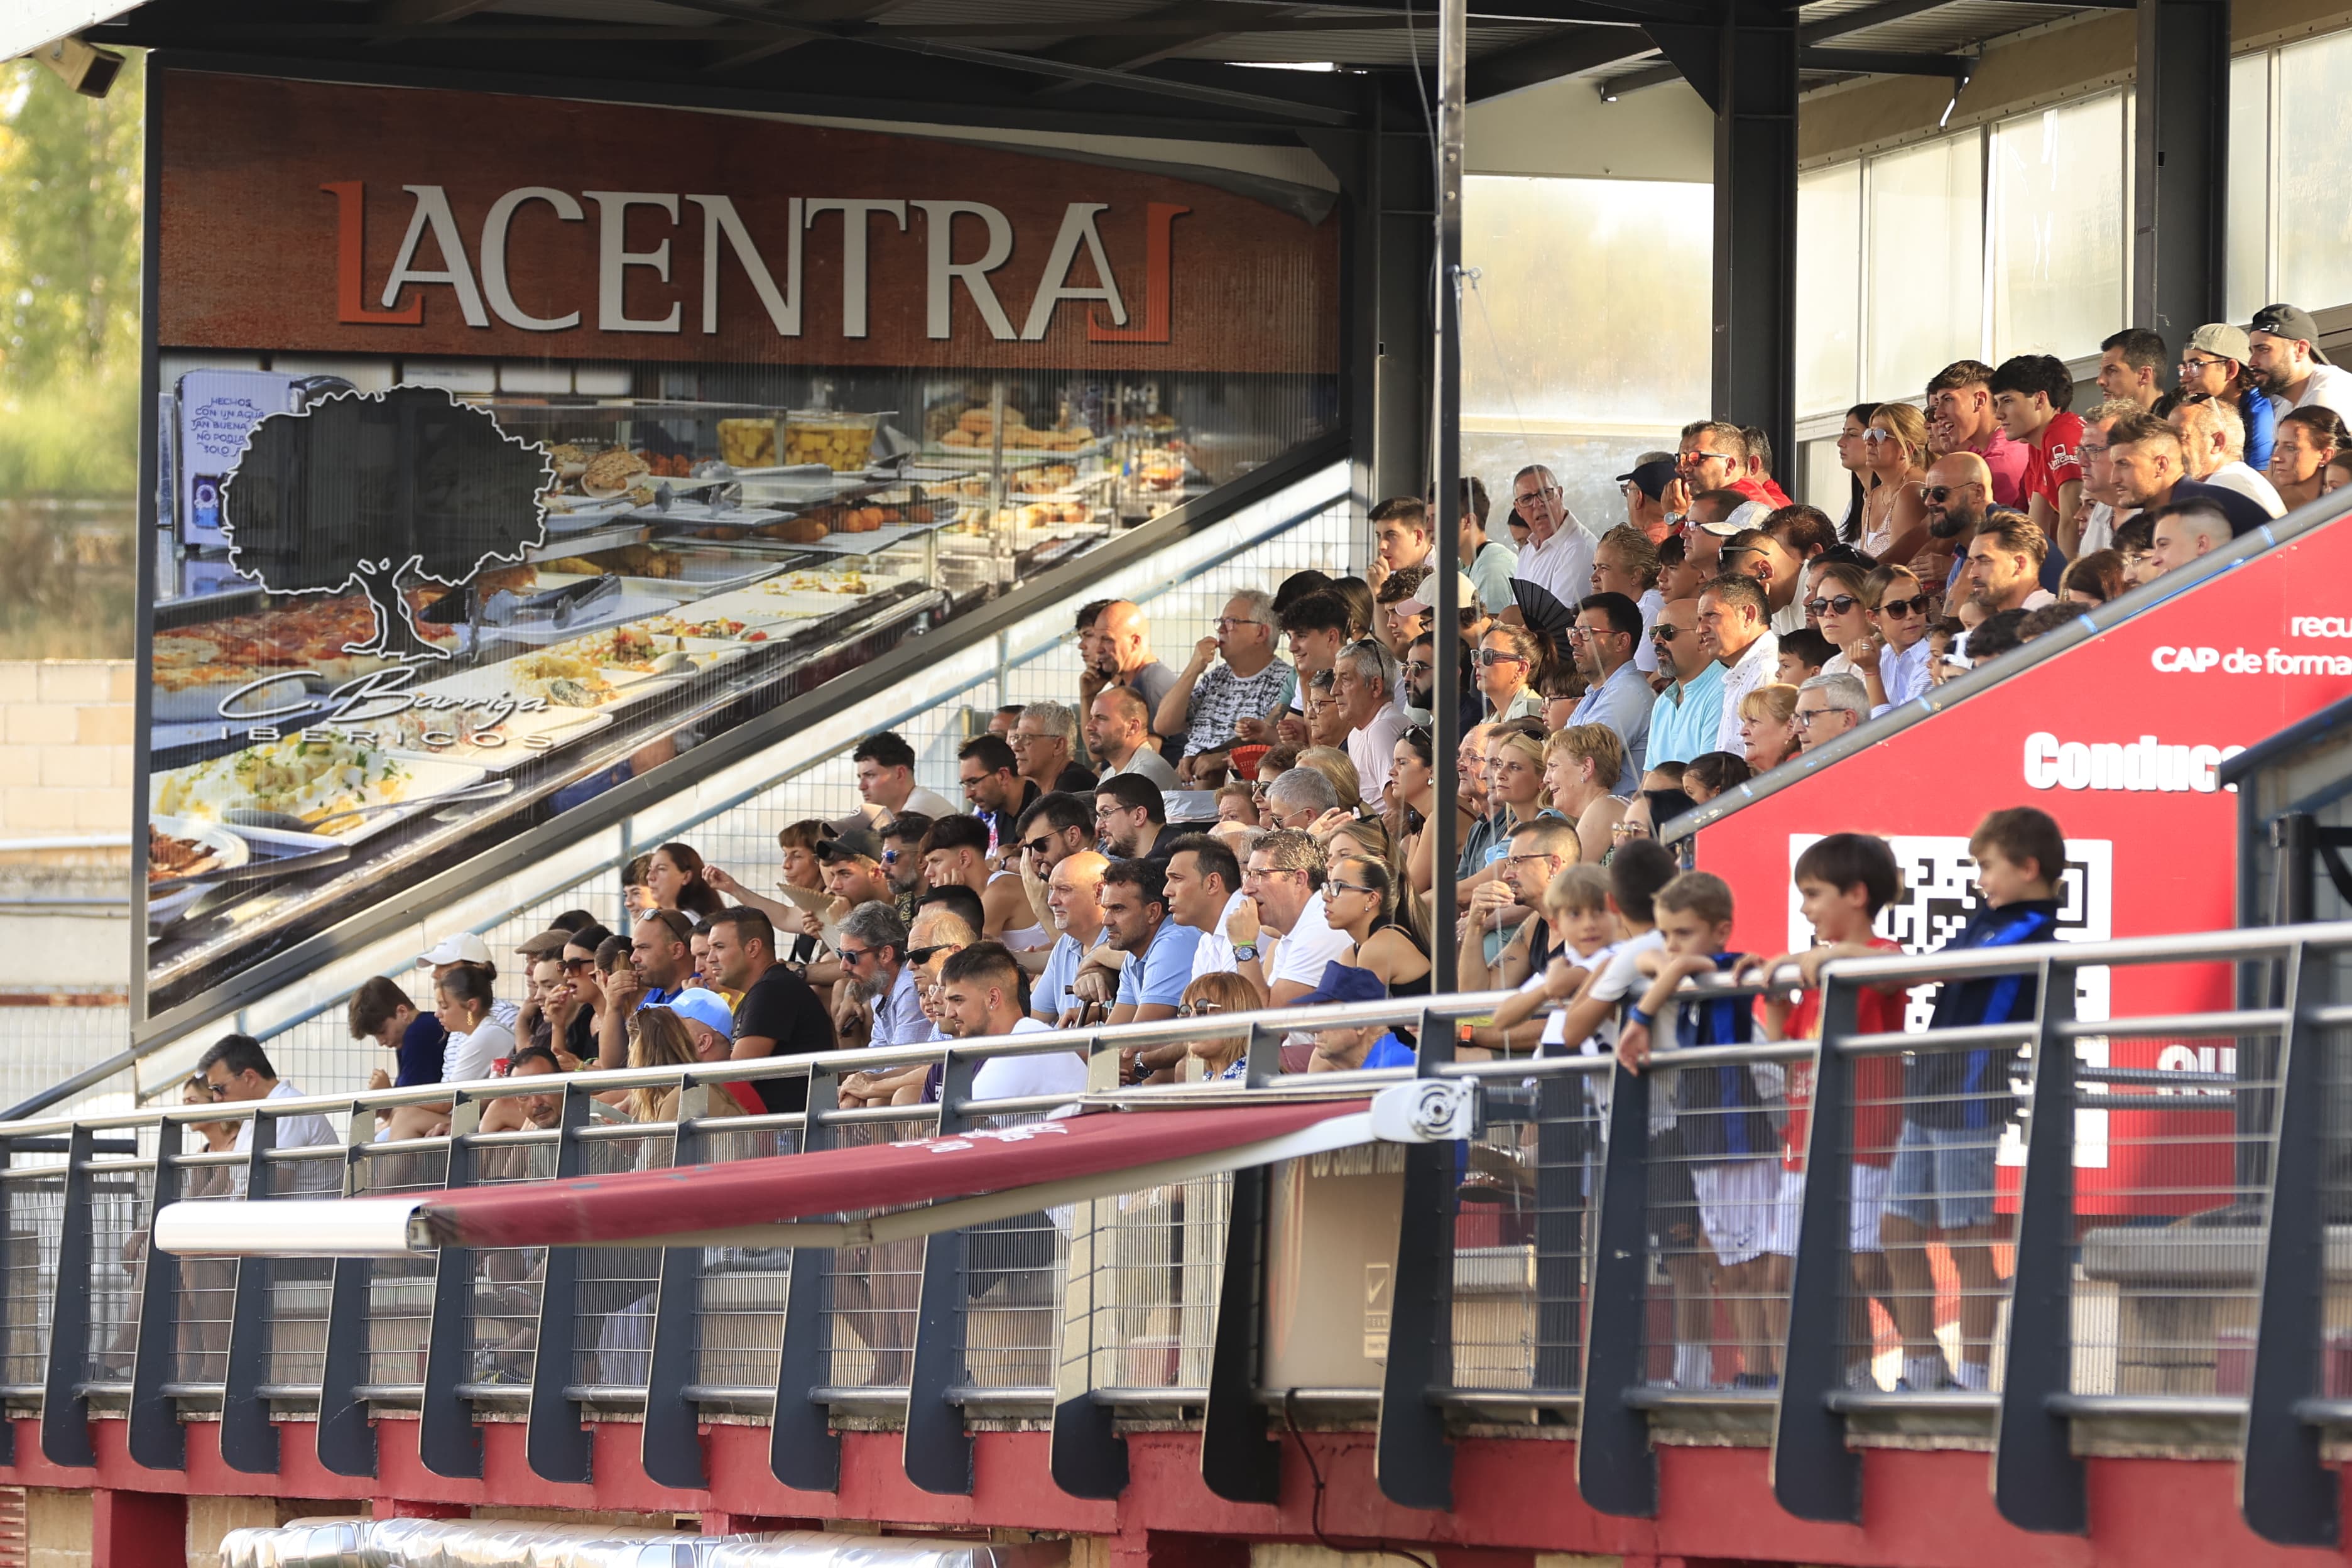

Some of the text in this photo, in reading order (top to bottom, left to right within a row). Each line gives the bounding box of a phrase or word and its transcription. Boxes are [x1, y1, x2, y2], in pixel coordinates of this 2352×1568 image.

[210, 397, 253, 408] HECHOS
[195, 408, 264, 422] CON UN AGUA
[213, 421, 246, 430] BUENA
[197, 430, 211, 440] NO
[204, 445, 230, 457] SOLO
[2291, 616, 2352, 638] recu
[2151, 646, 2352, 675] CAP de forma
[326, 666, 549, 730] Barriga
[220, 726, 553, 749] IBERICOS
[2024, 731, 2246, 793] Conduc
